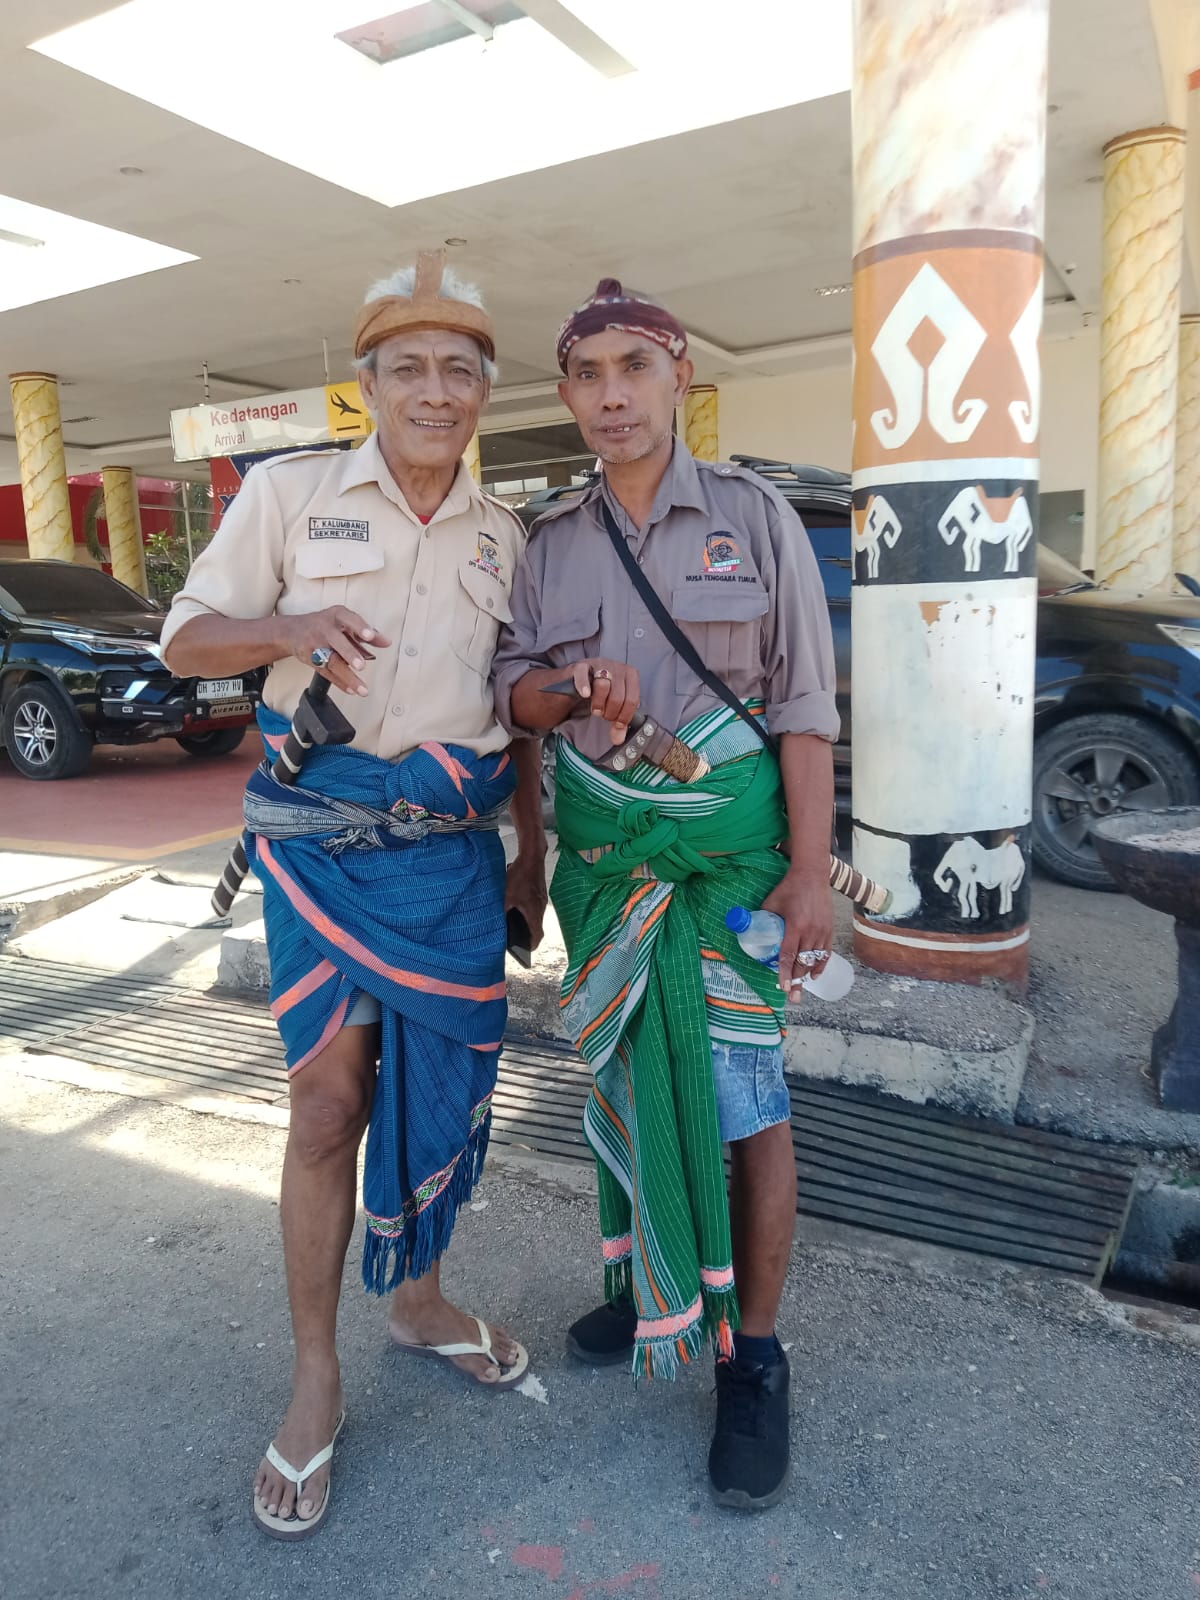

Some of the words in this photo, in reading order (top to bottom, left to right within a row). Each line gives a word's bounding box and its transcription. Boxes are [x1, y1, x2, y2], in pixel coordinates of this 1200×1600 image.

[210, 402, 298, 426] Kedatangan
[214, 430, 246, 447] Arrival
[312, 520, 319, 528] T.
[321, 521, 366, 530] KALUMBANG
[314, 530, 365, 539] SEKRETARIS
[212, 681, 229, 692] 1397
[211, 704, 250, 715] AVENGER
